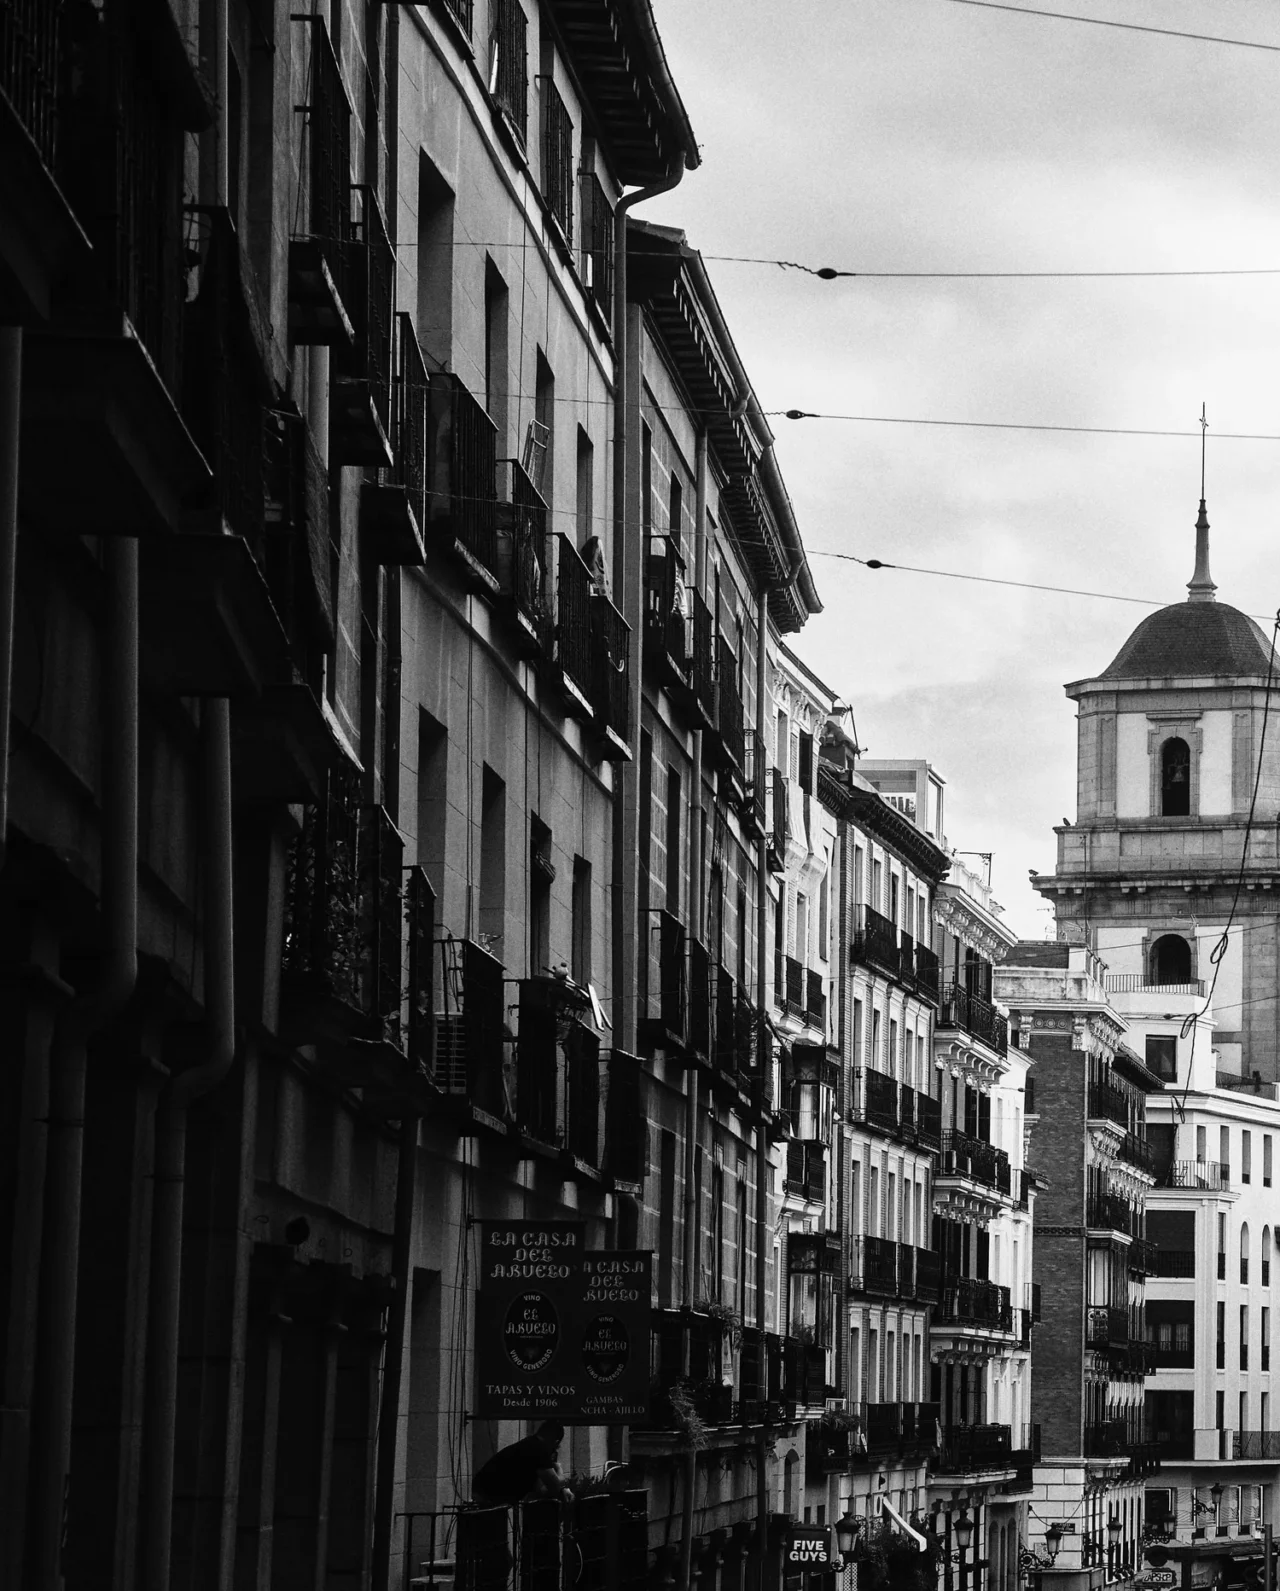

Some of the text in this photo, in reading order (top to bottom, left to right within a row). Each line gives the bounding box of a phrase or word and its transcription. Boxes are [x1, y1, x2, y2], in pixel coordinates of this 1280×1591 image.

[489, 1231, 577, 1246] LA CASA
[512, 1247, 554, 1262] DEL
[490, 1263, 570, 1278] ABUELO
[583, 1259, 645, 1273] A CASA
[588, 1274, 624, 1288] DEL
[523, 1294, 541, 1302] VINO
[582, 1288, 639, 1301] BUELO
[523, 1307, 539, 1320] EL
[505, 1321, 556, 1335] ABUELO
[598, 1328, 612, 1339] EL
[582, 1340, 627, 1352] ABUELO
[510, 1348, 553, 1370] VINO GENEROSO
[586, 1363, 625, 1383] VINO GENEROSO
[485, 1384, 576, 1396] TAPAS Y VINOS
[502, 1397, 558, 1407] Desde 1906
[585, 1395, 623, 1404] GAMBAS
[580, 1405, 646, 1415] NCHA AJILLO
[793, 1540, 824, 1551] FIVE
[789, 1550, 828, 1562] GUYS
